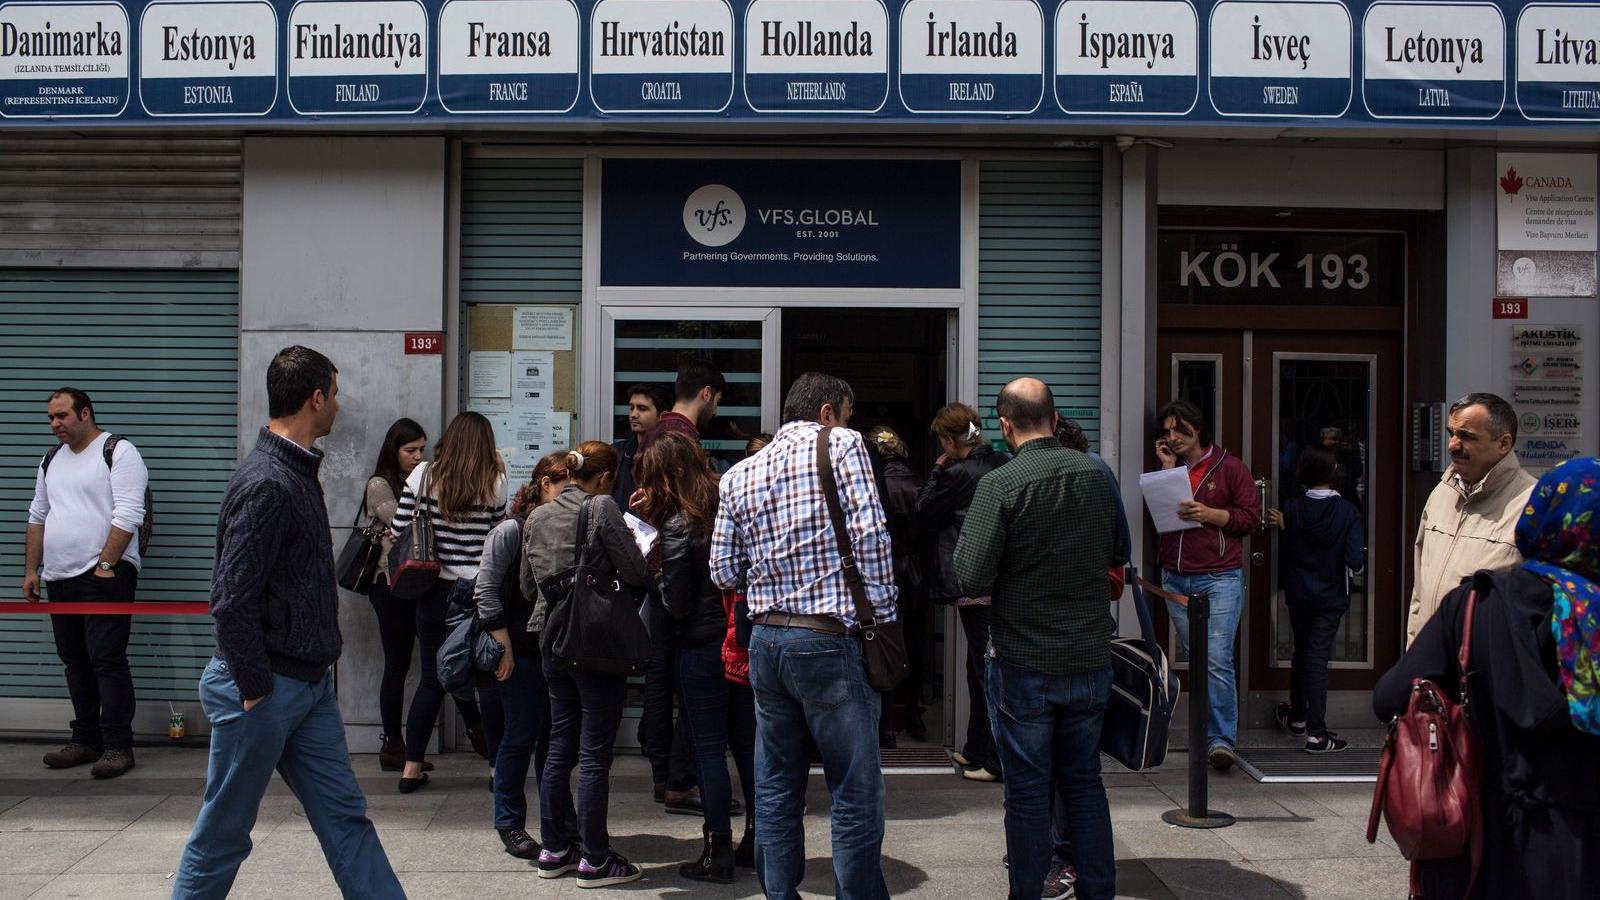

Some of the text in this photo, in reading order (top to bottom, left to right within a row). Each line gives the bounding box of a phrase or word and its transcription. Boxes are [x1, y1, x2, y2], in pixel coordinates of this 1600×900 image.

[0, 21, 123, 57] Danimarka
[467, 22, 551, 58] Fransa
[600, 20, 725, 57] Hırvatistan
[760, 20, 873, 57] Hollanda
[925, 11, 1018, 58] İrlanda
[1078, 12, 1176, 70] İspanya
[1251, 14, 1311, 71] İsveç
[161, 25, 256, 71] Estonya
[294, 21, 422, 69] Finlandiya
[1385, 26, 1484, 74] Letonya
[1535, 28, 1600, 65] Litva
[14, 64, 53, 73] (İZLANDA
[4, 96, 119, 105] (REPRESENTING ICELAND)
[38, 86, 84, 95] DENMARK
[183, 85, 234, 105] ESTONIA
[335, 83, 380, 102] FINLAND
[489, 82, 528, 101] FRANCE
[641, 81, 682, 101] CROATIA
[787, 81, 846, 101] NETHERLANDS
[949, 82, 995, 101] IRELAND
[1109, 81, 1144, 103] ESPAÑA
[1263, 86, 1299, 105] SWEDEN
[1418, 88, 1451, 107] LATVIA
[1525, 176, 1573, 189] CANADA
[694, 199, 879, 232] vfs. VFS.GLOBAL
[796, 230, 839, 238] EST. 2001
[683, 251, 879, 263] Partnering Governments. Providing Solutions.
[1180, 243, 1370, 290] KÖK 193
[1500, 302, 1521, 314] 193
[1520, 328, 1576, 339] AKUSTİK
